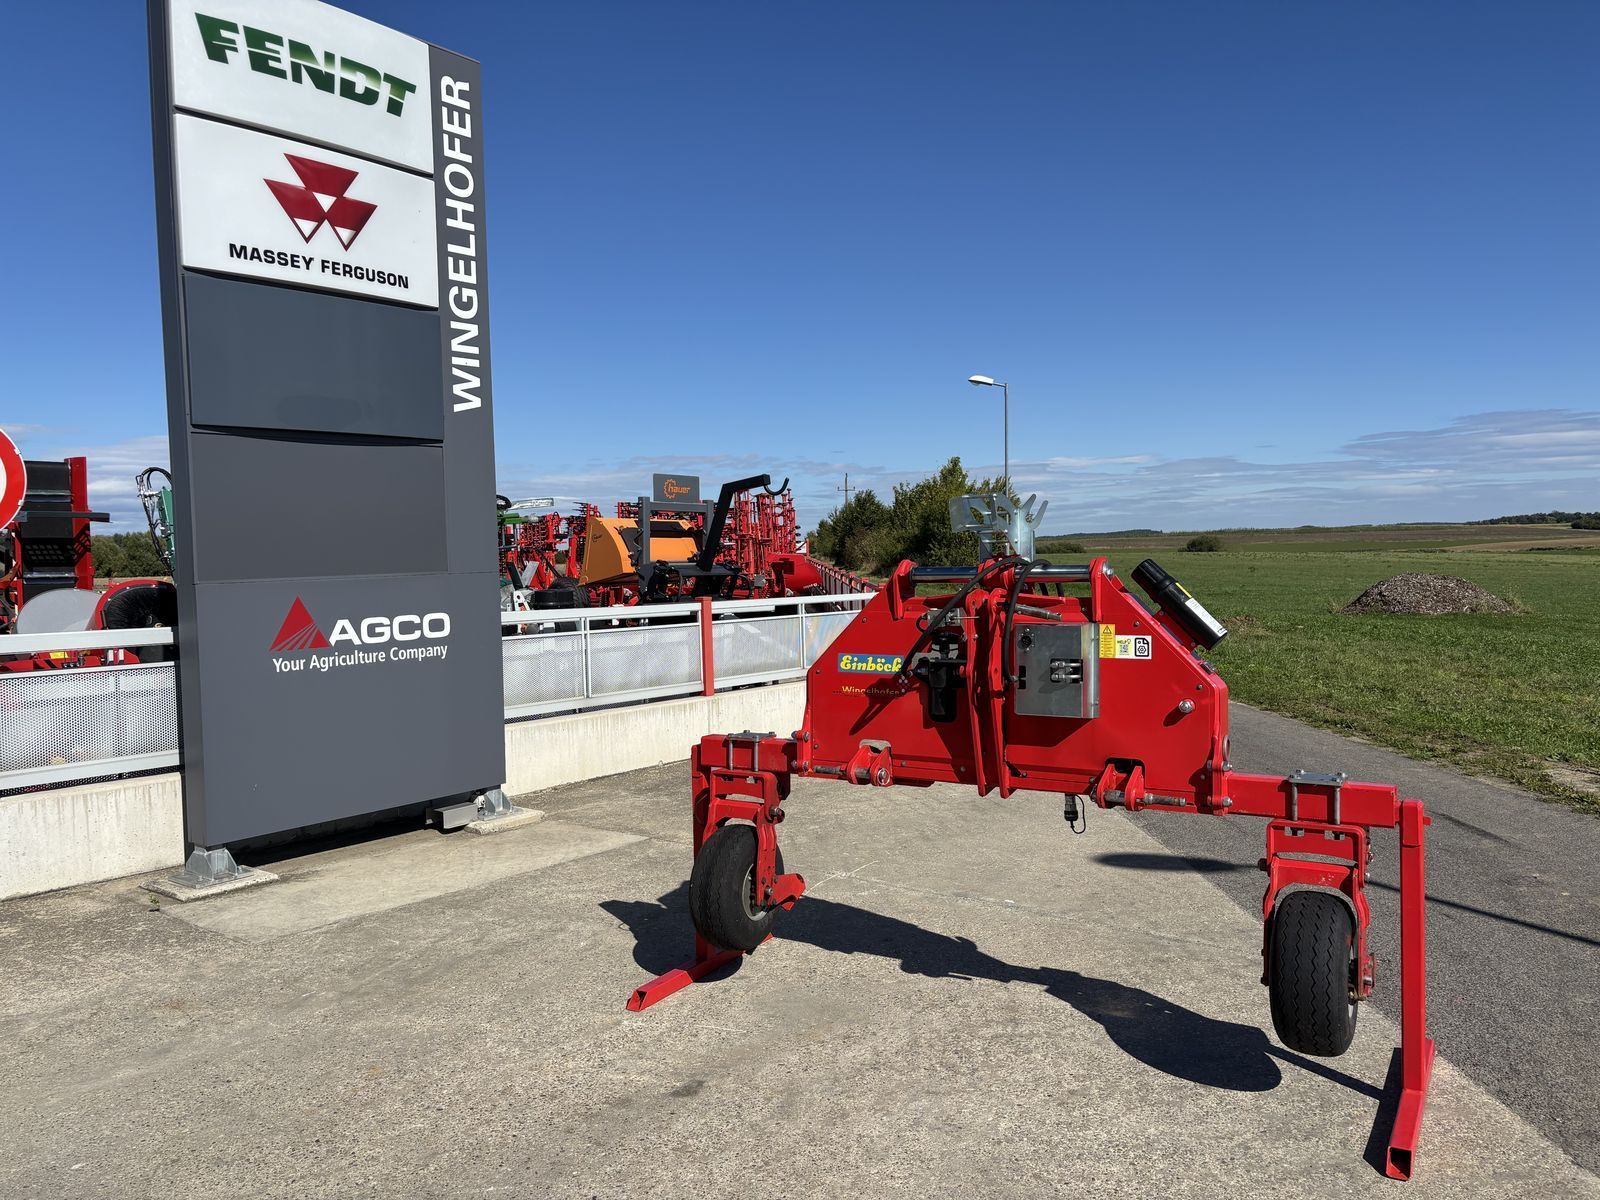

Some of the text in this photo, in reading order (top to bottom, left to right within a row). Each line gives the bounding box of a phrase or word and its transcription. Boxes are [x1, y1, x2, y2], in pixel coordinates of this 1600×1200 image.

[194, 12, 417, 118] FENDT
[440, 74, 482, 413] WINGELHOFER
[228, 243, 409, 289] MASSEY FERGUSON
[328, 612, 451, 647] AGCO
[272, 645, 448, 673] Your Agriculture Company
[840, 655, 902, 672] Einböck
